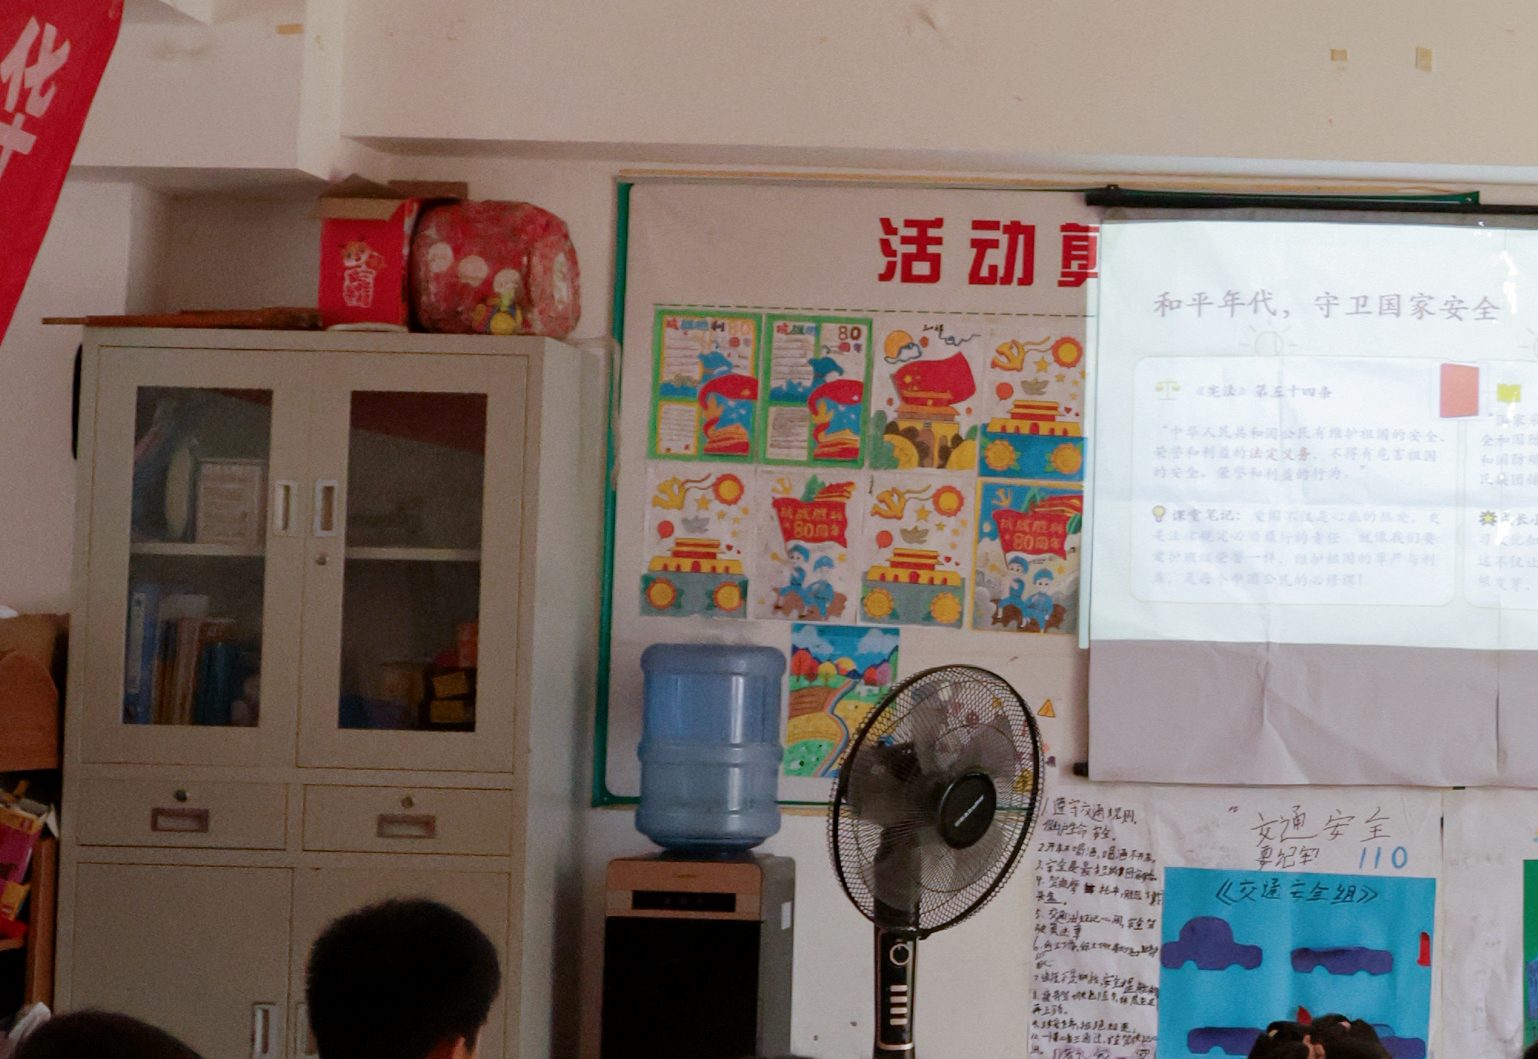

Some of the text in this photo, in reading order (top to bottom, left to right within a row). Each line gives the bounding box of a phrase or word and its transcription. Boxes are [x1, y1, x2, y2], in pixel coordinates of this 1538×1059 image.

[1154, 288, 1501, 321] 和平年代，守卫国家安全
[838, 325, 862, 341] 80
[1196, 383, 1333, 400] 《宪法》第五十四条
[1251, 805, 1391, 847] 交通安全
[1359, 845, 1408, 869] 110
